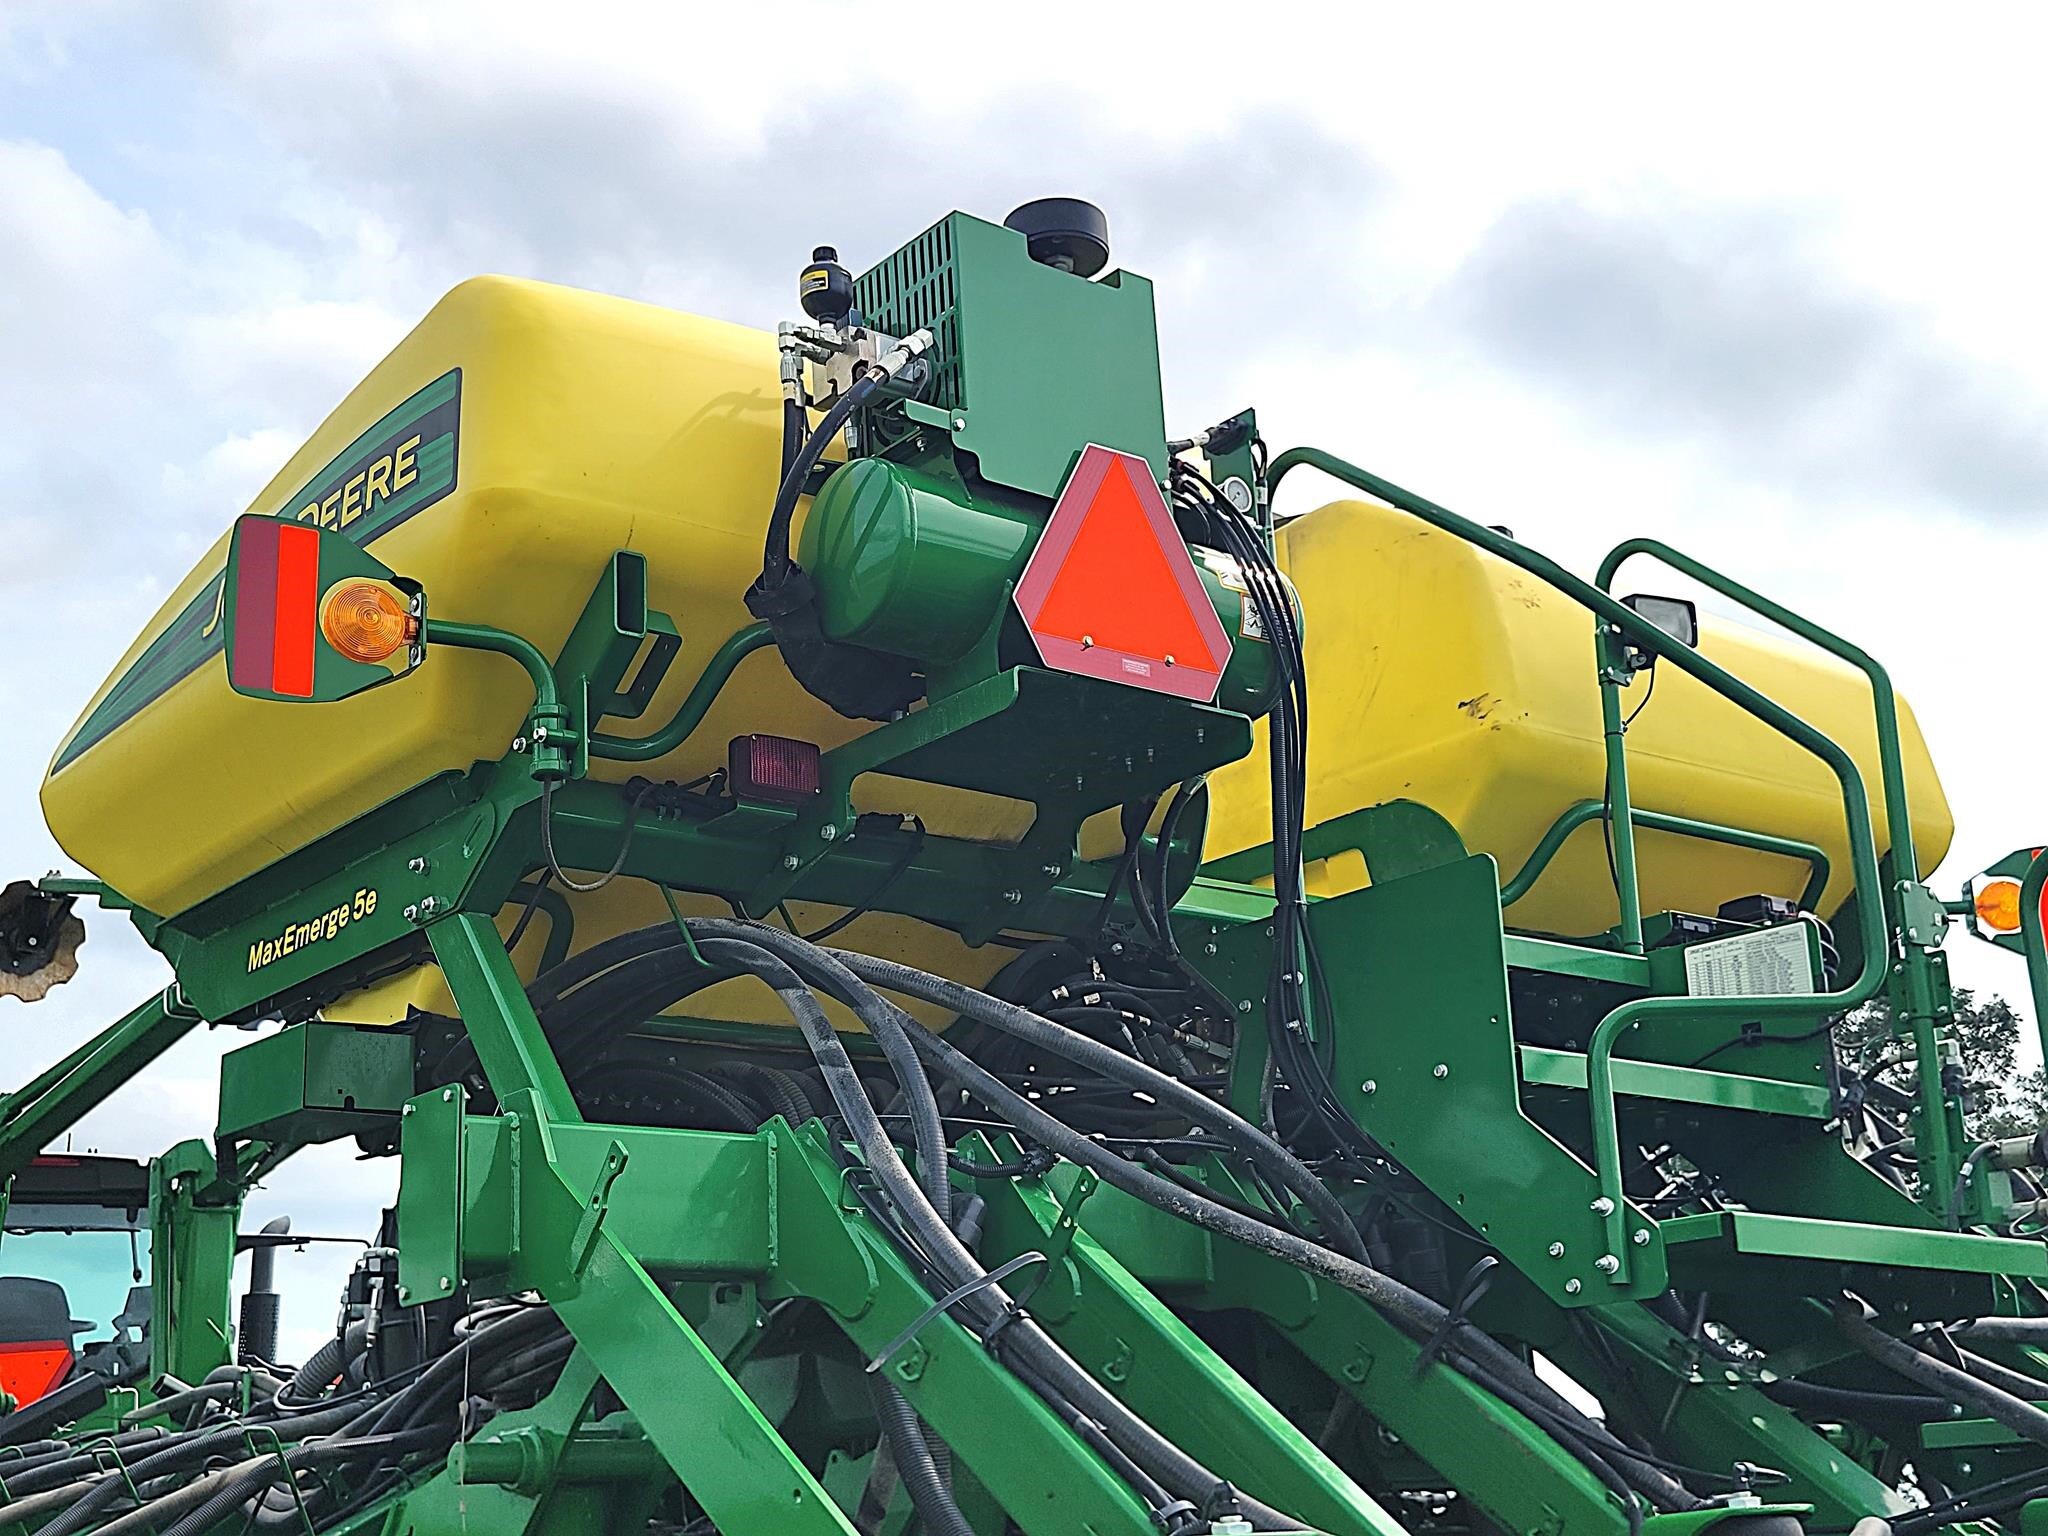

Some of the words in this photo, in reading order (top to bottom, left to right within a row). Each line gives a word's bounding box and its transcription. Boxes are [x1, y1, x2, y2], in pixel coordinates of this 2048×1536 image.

[297, 434, 421, 532] DEERE
[247, 903, 350, 973] MaxEmerge
[353, 888, 377, 920] 5e
